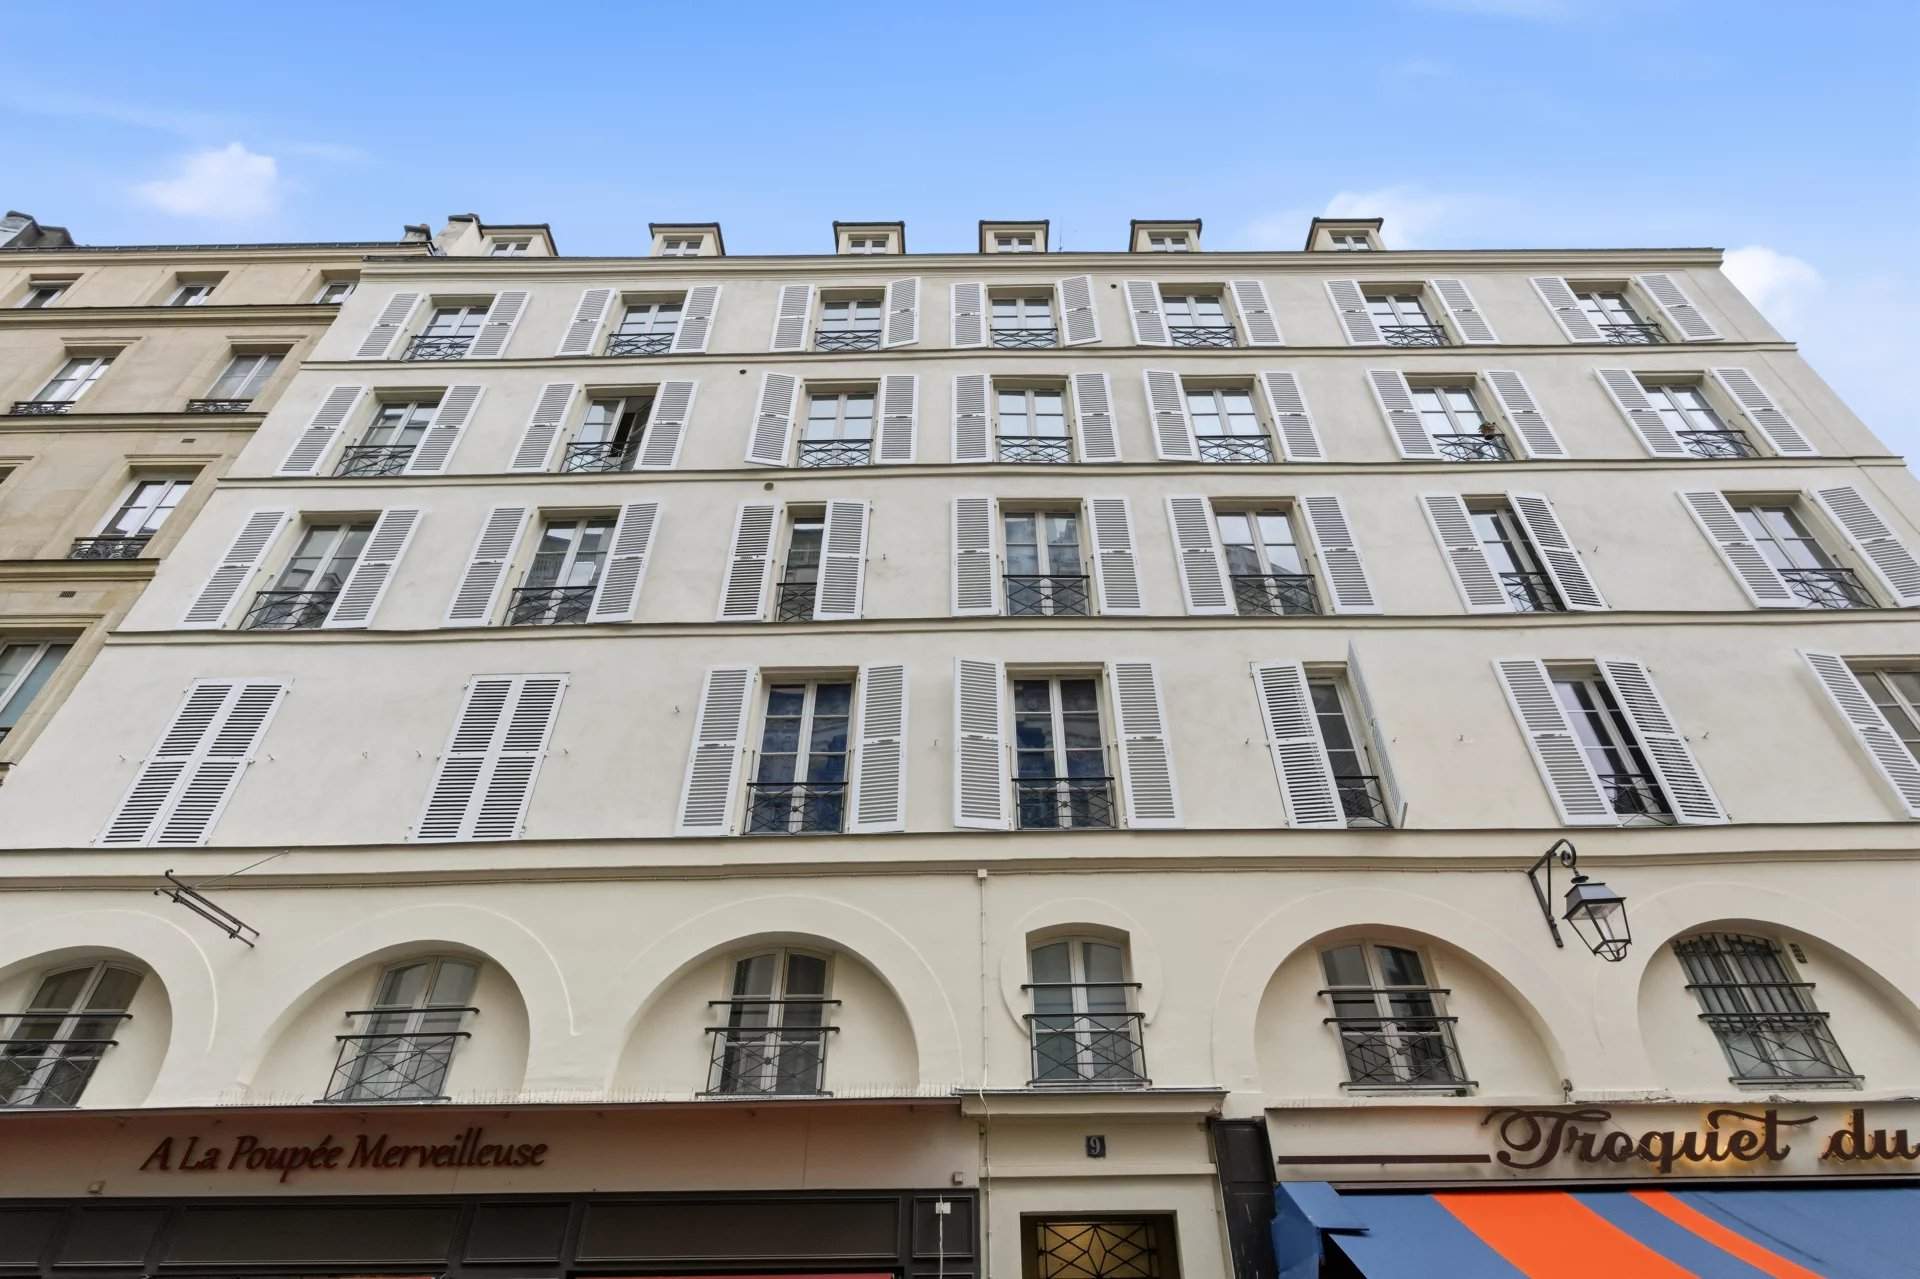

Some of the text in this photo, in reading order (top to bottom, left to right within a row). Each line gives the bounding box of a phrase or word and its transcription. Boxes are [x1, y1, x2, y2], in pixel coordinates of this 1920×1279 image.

[139, 1127, 548, 1183] A La Poupée Merveilleuse
[1089, 1136, 1101, 1155] 9
[1481, 1109, 1819, 1173] Troquet
